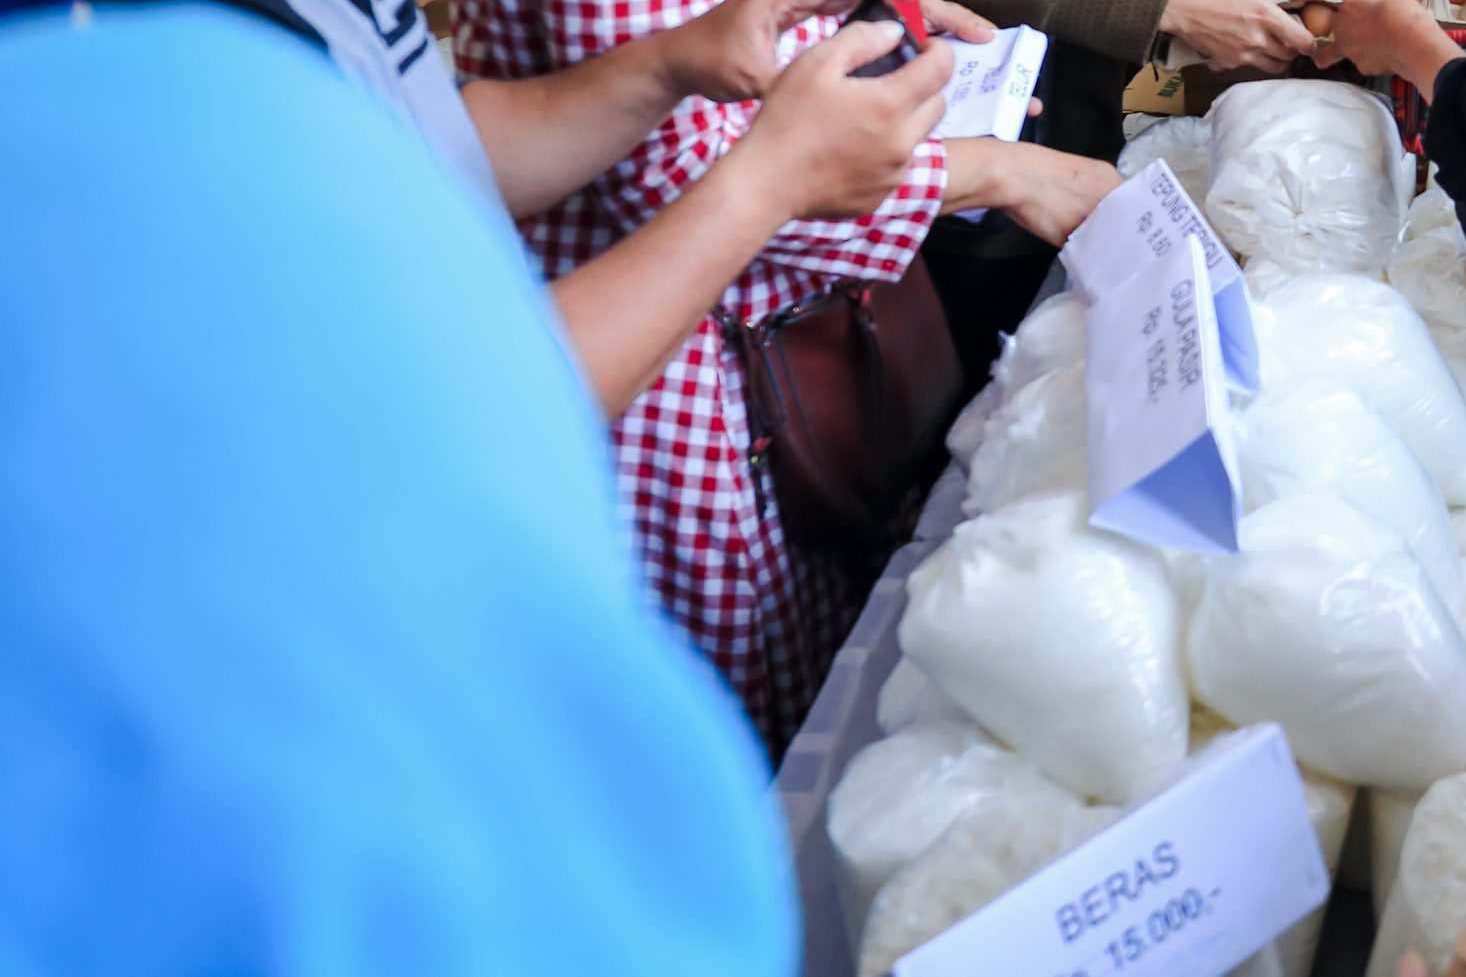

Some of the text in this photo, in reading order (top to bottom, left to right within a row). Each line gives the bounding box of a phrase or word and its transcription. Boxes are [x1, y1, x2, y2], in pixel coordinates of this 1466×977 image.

[1150, 173, 1188, 223] TEPUNG
[1170, 278, 1201, 394] GULA PASIR
[1055, 839, 1181, 944] BERAS
